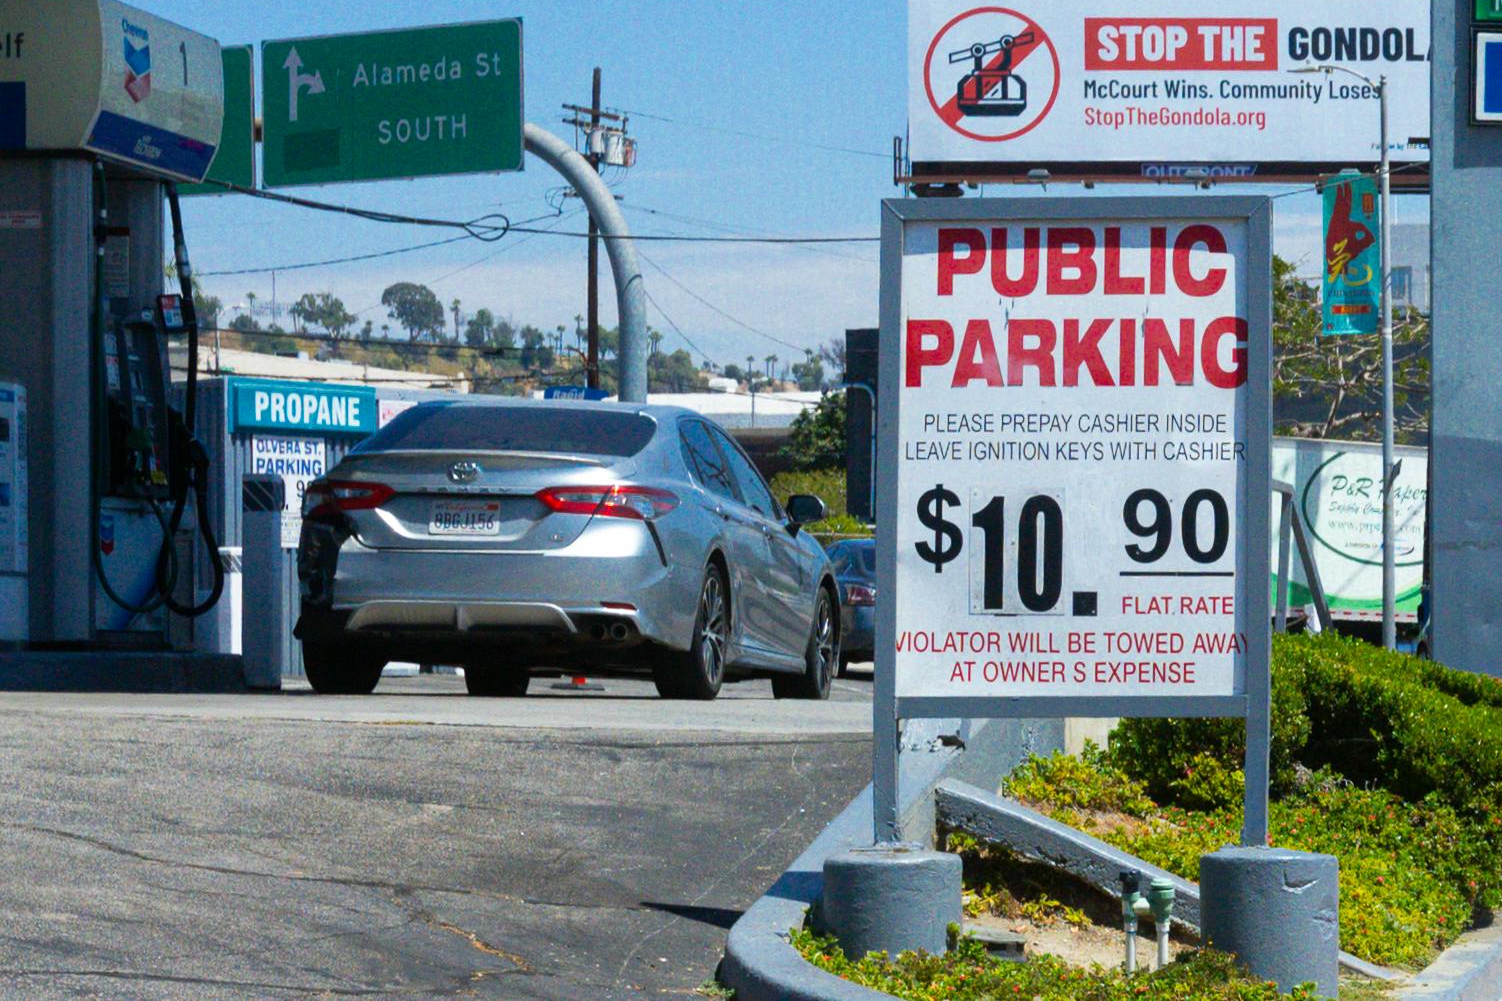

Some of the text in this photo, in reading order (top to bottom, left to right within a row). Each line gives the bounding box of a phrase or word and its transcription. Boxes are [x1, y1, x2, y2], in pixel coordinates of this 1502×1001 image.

[0, 32, 24, 59] lf
[1098, 26, 1187, 62] STOP
[1198, 26, 1265, 62] THE
[179, 42, 188, 86] 1
[352, 52, 502, 88] Alameda St
[1084, 80, 1158, 100] McCourt
[1164, 80, 1213, 100] Wins.
[1219, 80, 1322, 104] Community
[378, 114, 468, 144] SOUTH
[1084, 107, 1266, 130] StopTheGondola.org
[1146, 165, 1251, 177] OUTRONT
[936, 224, 1228, 297] PUBLIC
[905, 315, 1248, 389] PARKING
[255, 390, 360, 427] PROPANE
[924, 413, 1227, 434] PLEASE PREPAY CASHIER INSIDE
[256, 439, 322, 456] OLVERA ST.
[905, 441, 1246, 461] LEAVE IGNITION KEYS WITH CASHIER
[256, 458, 322, 477] PARKING
[1331, 475, 1373, 498] P&R
[1122, 488, 1230, 565] 90
[1122, 596, 1234, 615] FLAT RATE
[896, 631, 1001, 654] VIOLATOR
[1008, 631, 1060, 654] WILL
[1067, 631, 1096, 654] BE
[1104, 631, 1184, 654] TOWED
[949, 661, 977, 683] AT
[983, 661, 1066, 683] OWNER
[1094, 661, 1196, 684] EXPENSE
